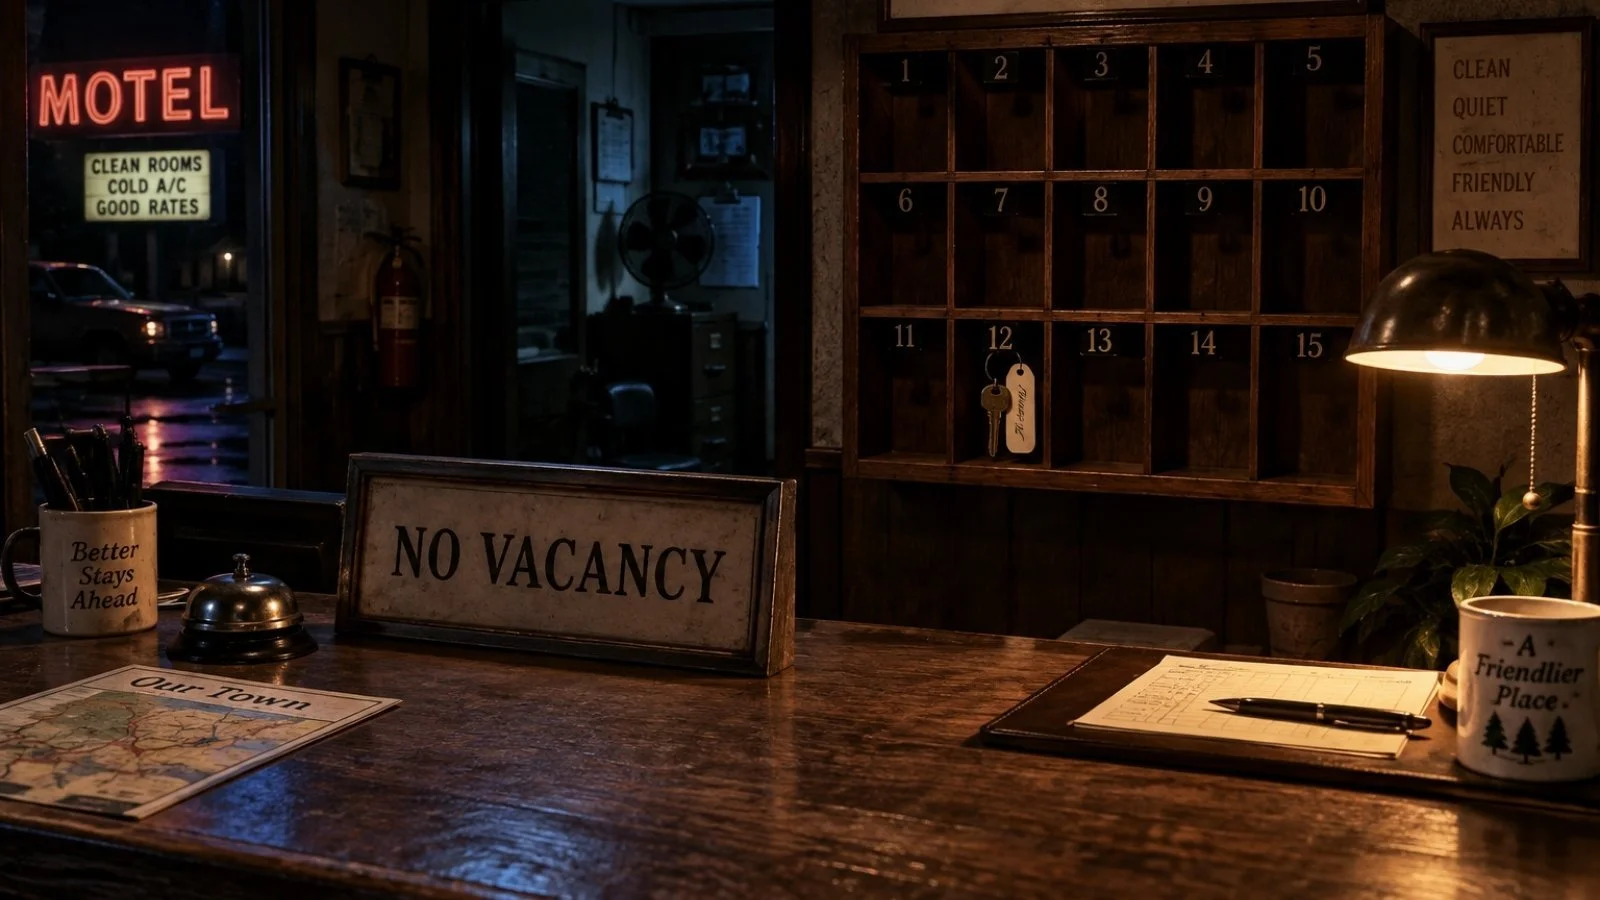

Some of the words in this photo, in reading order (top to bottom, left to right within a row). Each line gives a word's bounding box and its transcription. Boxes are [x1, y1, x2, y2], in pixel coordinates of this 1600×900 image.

[900, 58, 911, 83] 1
[993, 54, 1010, 80] 2
[1094, 51, 1109, 77] 3
[1196, 48, 1214, 75] 4
[1306, 45, 1322, 72] 5
[1453, 58, 1511, 80] CLEAN
[38, 65, 229, 127] MOTEL
[1452, 96, 1508, 119] QUIET
[1452, 132, 1564, 155] COMFORTABLE
[92, 157, 140, 174] CLEAN
[148, 156, 202, 172] ROOMS
[107, 178, 149, 195] COLD
[156, 177, 187, 194] A/C
[1452, 171, 1535, 193] FRIENDLY
[96, 199, 140, 215] GOOD
[148, 198, 199, 215] RATES
[898, 187, 913, 213] 6
[994, 187, 1009, 213] 7
[1093, 185, 1108, 213] 8
[1197, 186, 1213, 212] 9
[1299, 185, 1327, 212] 10
[1452, 210, 1524, 231] ALWAYS
[894, 323, 915, 348] 11
[987, 325, 1014, 351] 12
[1086, 327, 1114, 353] 13
[1190, 329, 1217, 356] 14
[1296, 332, 1324, 359] 15
[70, 538, 140, 564] Better
[78, 564, 136, 588] Stays
[392, 525, 461, 582] NO
[481, 532, 727, 604] VACANCY
[70, 586, 138, 611] Ahead
[1516, 633, 1536, 657] A
[1474, 654, 1585, 684] Friendlier
[130, 676, 204, 695] Our
[206, 686, 312, 712] Town
